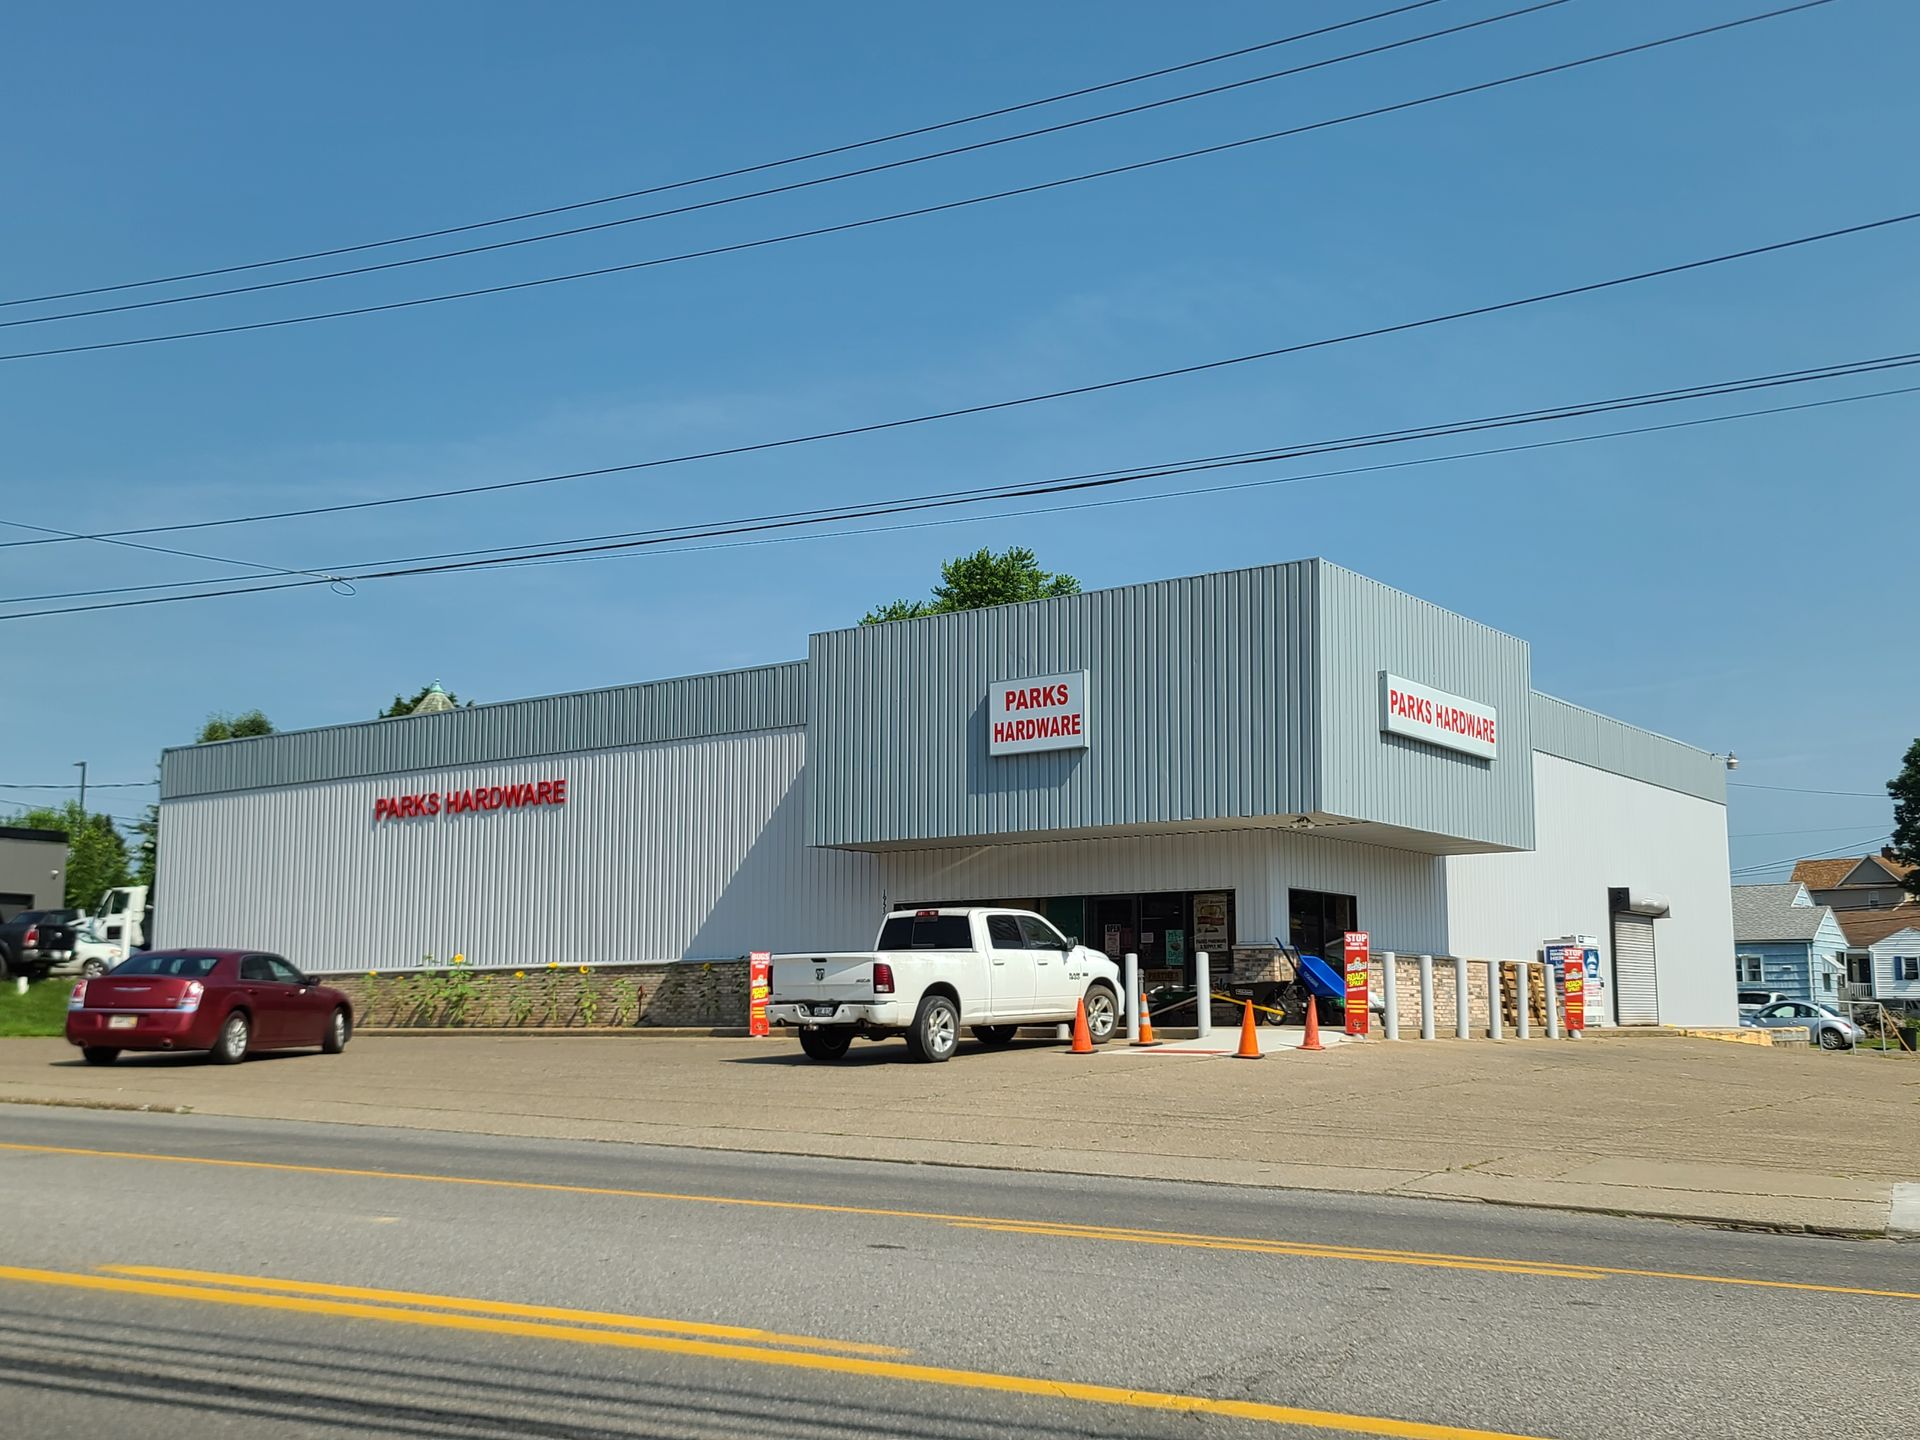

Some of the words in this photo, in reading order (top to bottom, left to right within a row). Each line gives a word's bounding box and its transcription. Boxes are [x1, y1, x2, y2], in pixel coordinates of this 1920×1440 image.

[1005, 684, 1069, 712] PARKS
[993, 713, 1081, 743] HARDWARE
[1389, 689, 1433, 725] PARKS
[1435, 703, 1496, 744] HARDWARE
[375, 791, 442, 822] PARKS
[445, 779, 566, 815] HARDWARE
[1345, 933, 1368, 943] STOP
[1564, 949, 1583, 957] STOP
[1346, 972, 1367, 983] ROACH
